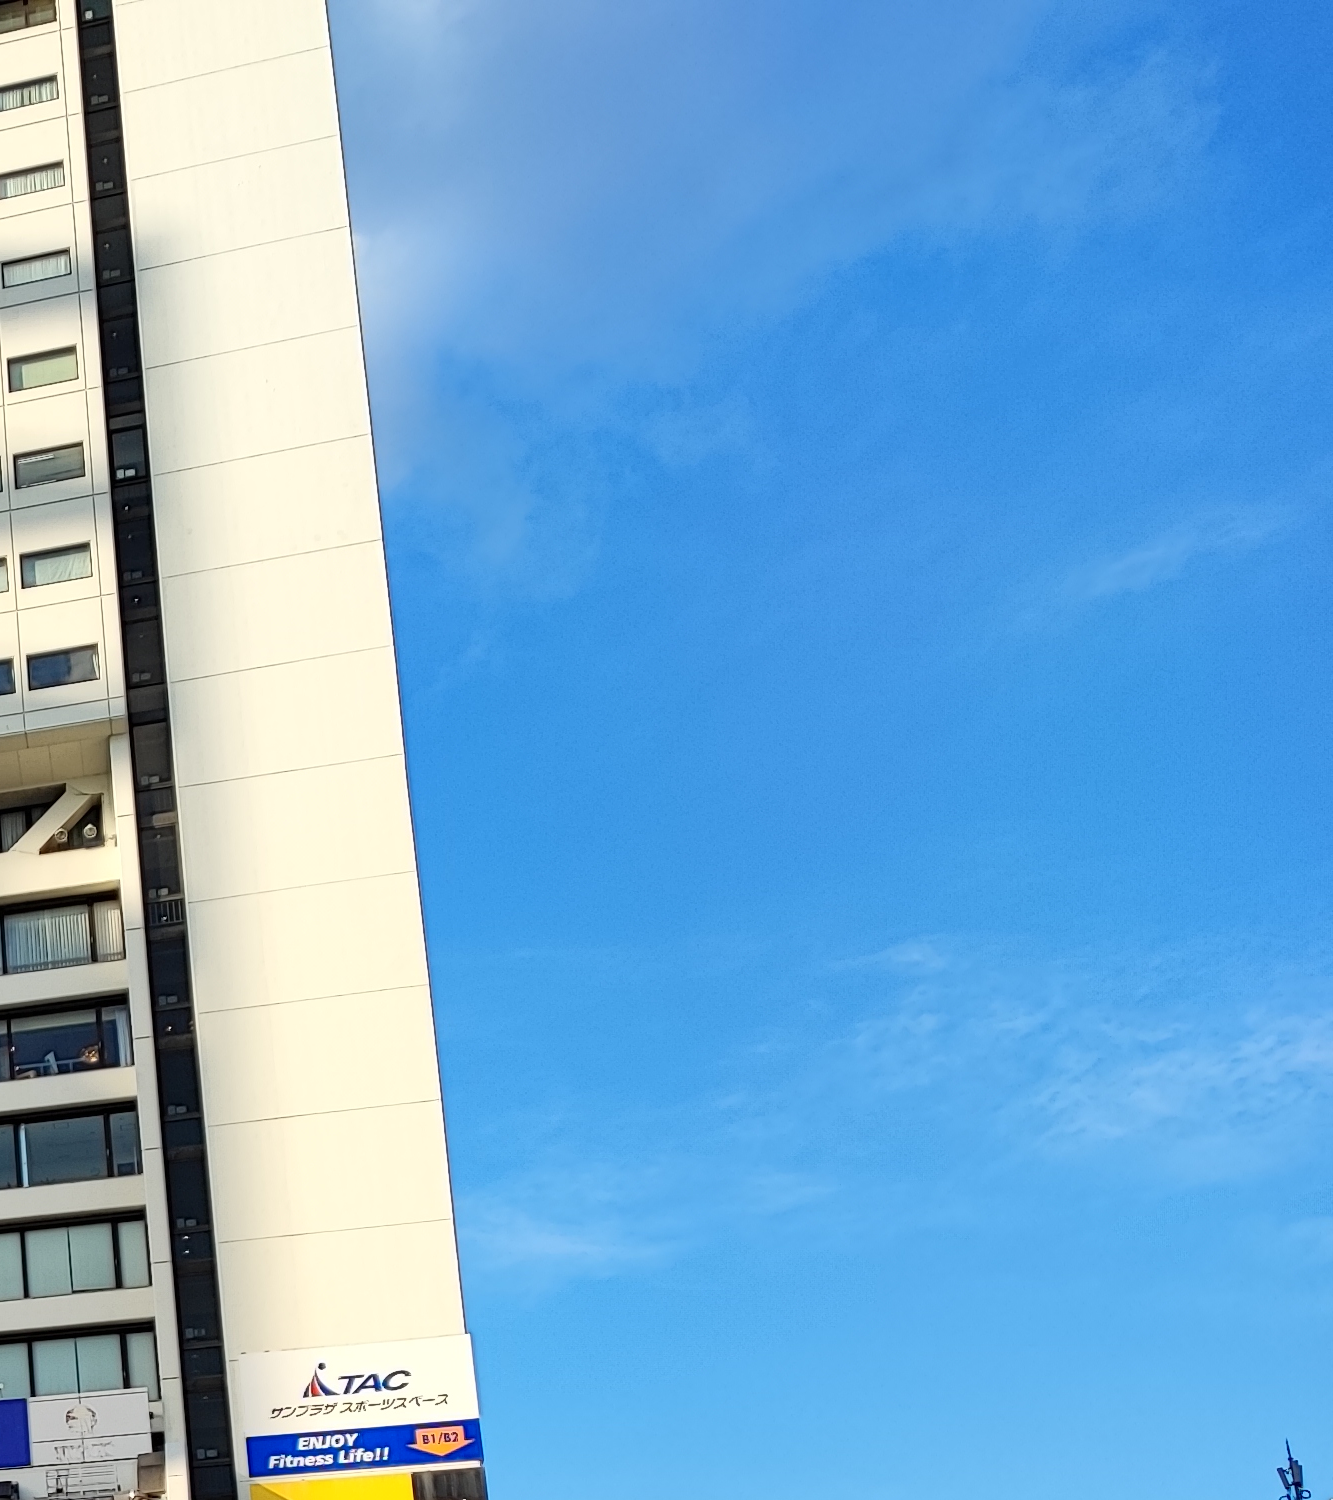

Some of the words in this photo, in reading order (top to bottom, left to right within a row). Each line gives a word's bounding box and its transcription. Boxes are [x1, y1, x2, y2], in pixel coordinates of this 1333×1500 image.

[338, 1370, 411, 1396] TAC
[297, 1433, 358, 1451] ENJOY
[421, 1431, 460, 1445] B1/B2
[268, 1451, 334, 1469] Fitness
[338, 1446, 389, 1465] Life!!
